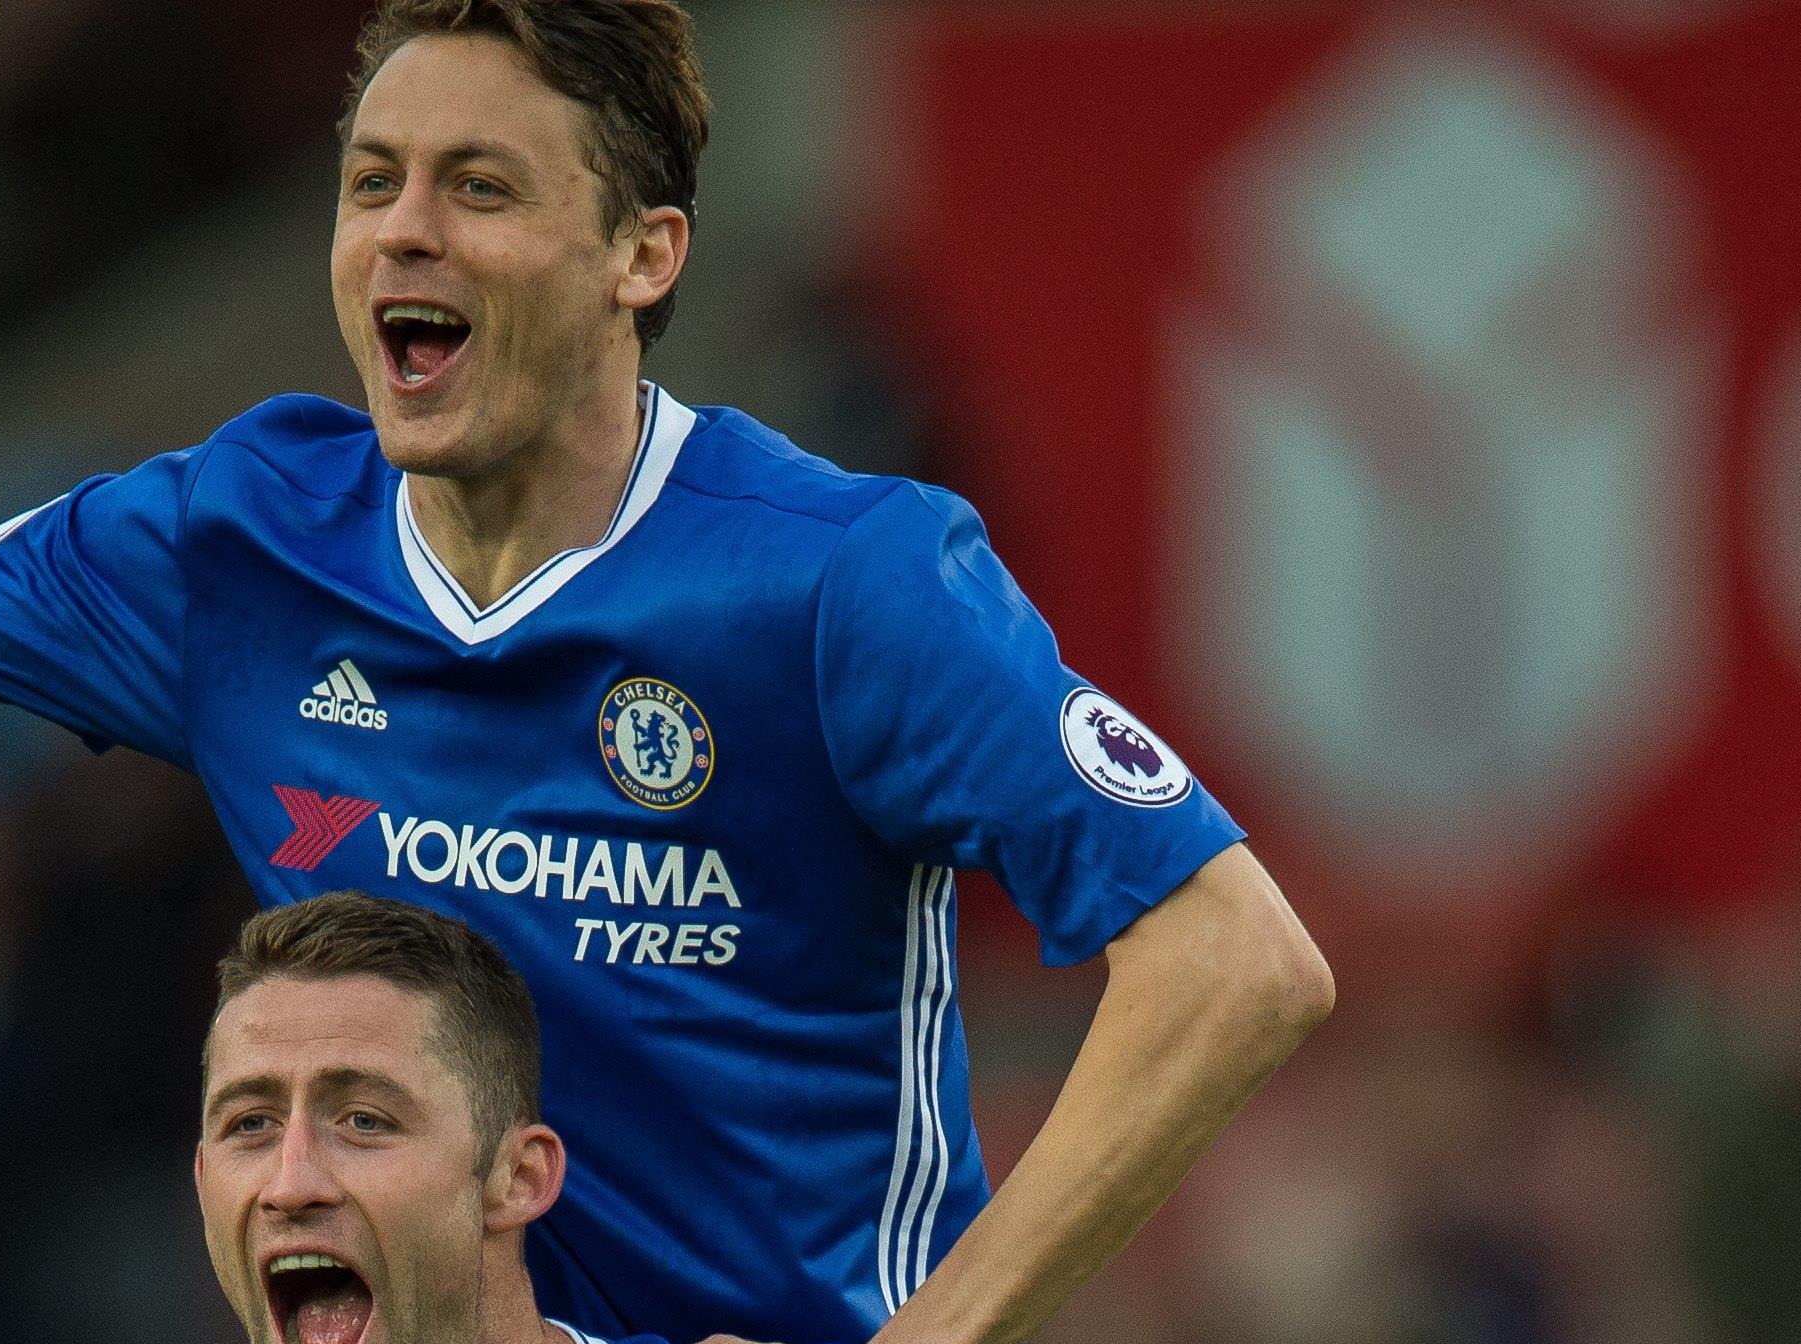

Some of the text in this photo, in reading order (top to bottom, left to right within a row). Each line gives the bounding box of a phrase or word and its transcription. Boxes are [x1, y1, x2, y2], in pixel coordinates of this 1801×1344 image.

[299, 696, 388, 730] adidas
[614, 683, 686, 716] CHELSEA
[620, 774, 696, 803] FOOTBALL CLUB
[1093, 764, 1137, 794] Premier
[378, 812, 742, 908] YOKOHAMA
[573, 918, 742, 966] TYRES
